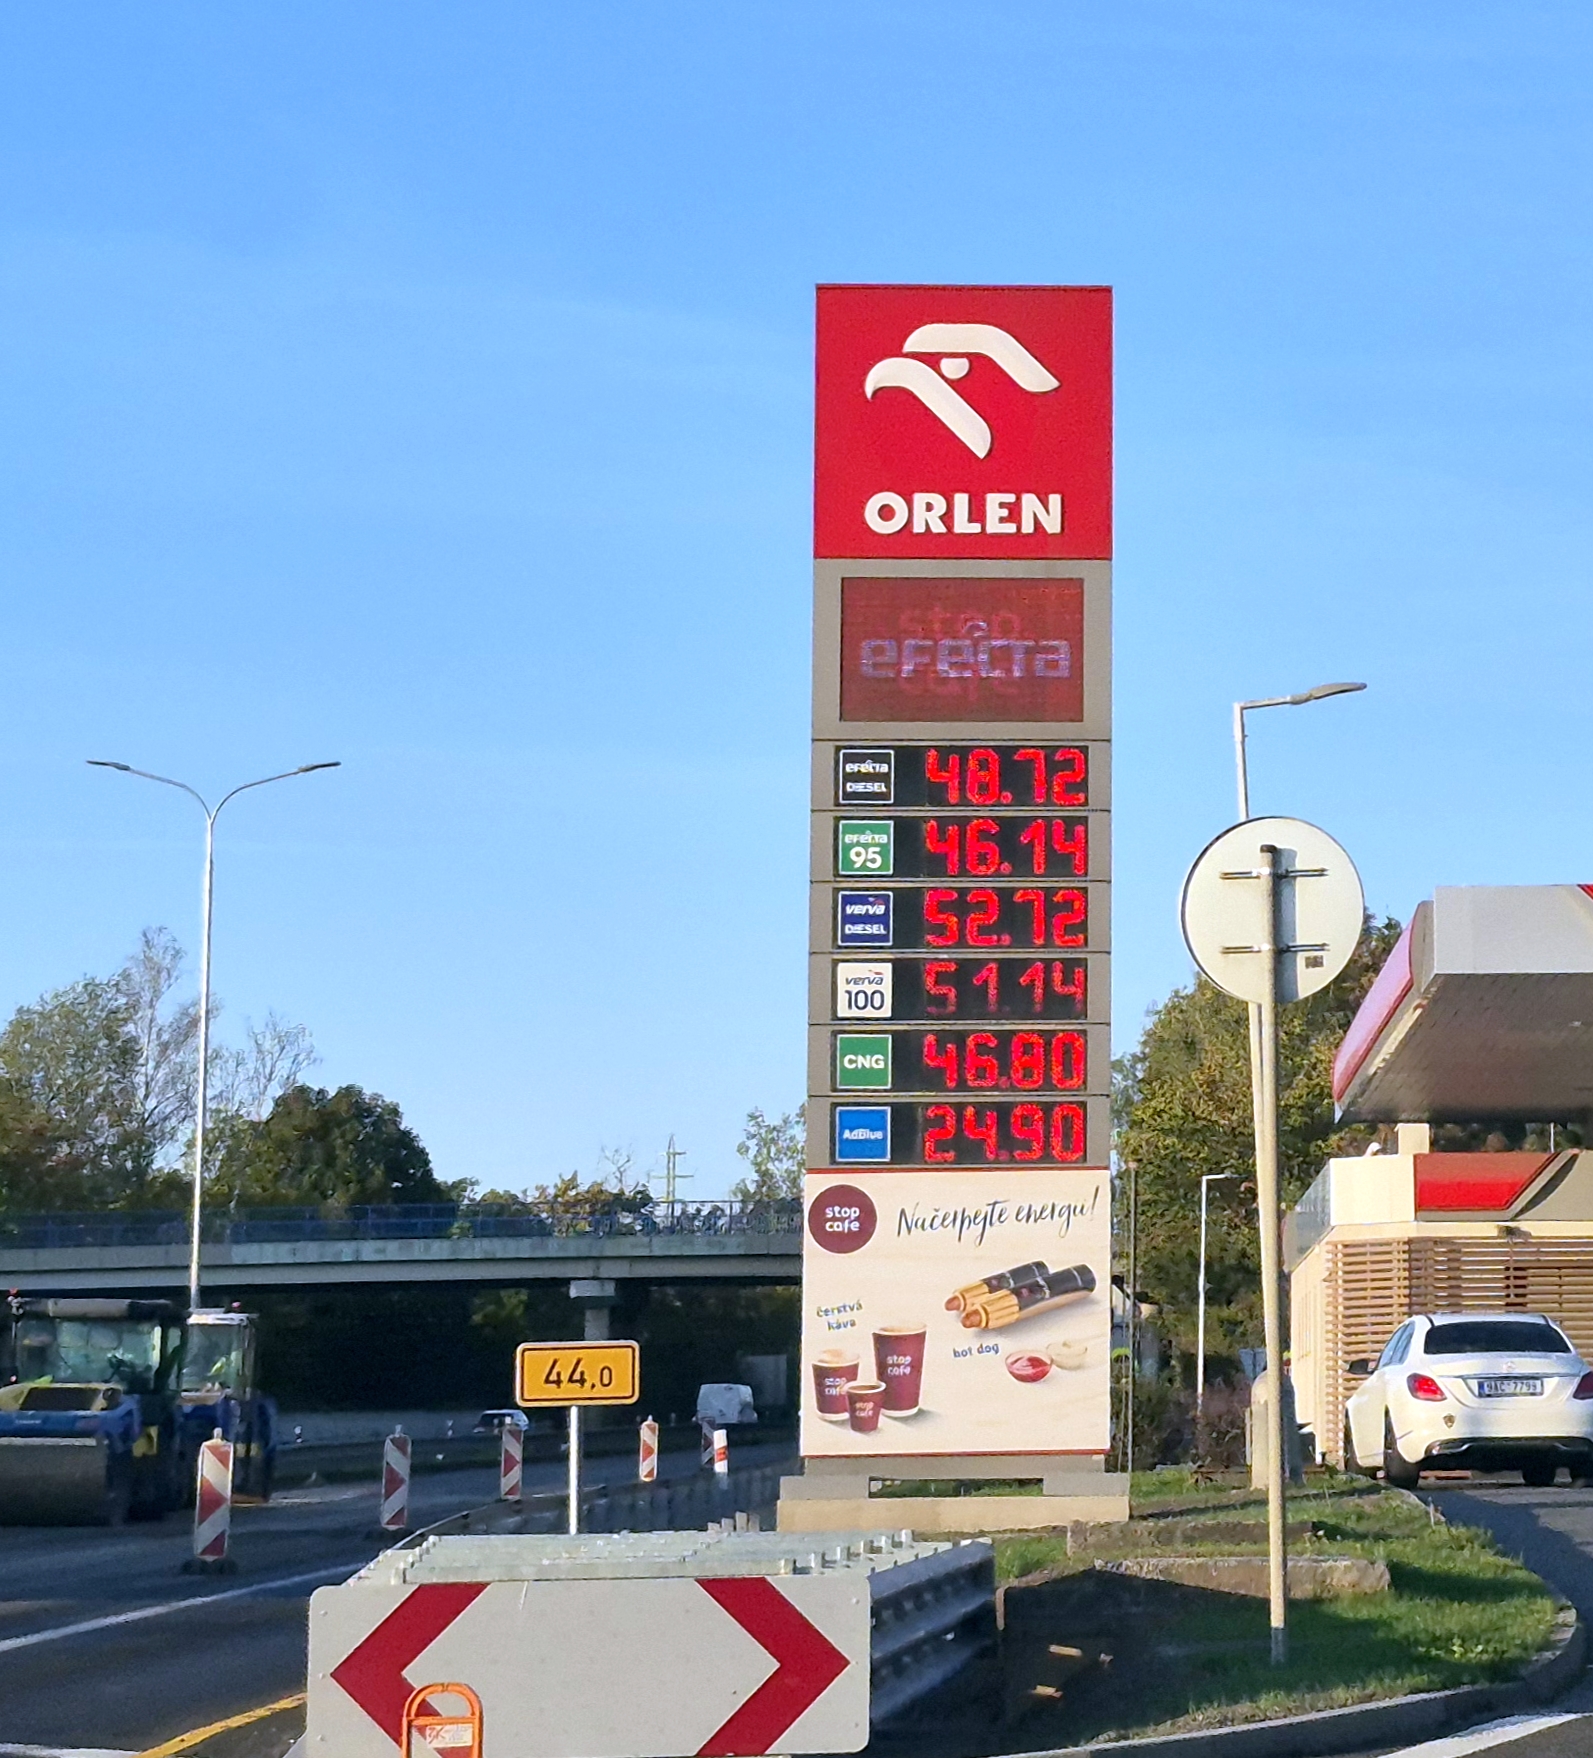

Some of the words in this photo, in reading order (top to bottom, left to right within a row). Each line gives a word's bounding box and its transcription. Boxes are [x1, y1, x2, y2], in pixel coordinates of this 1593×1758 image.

[864, 491, 1062, 535] ORLEN
[925, 748, 1086, 805] 48.72
[846, 782, 887, 792] DIESEL
[925, 818, 1086, 876] 46.14
[849, 846, 883, 869] 95
[845, 904, 886, 915] verva
[924, 888, 1086, 946] 52.72
[844, 924, 887, 935] DIESEL
[845, 974, 883, 986] verva
[844, 989, 885, 1011] 100
[843, 1054, 885, 1069] CNG
[923, 1032, 1086, 1090] 46.80
[843, 1128, 883, 1140] AdBlue
[923, 1103, 1085, 1162] 24.90
[825, 1205, 860, 1220] stop
[825, 1218, 860, 1234] cafe
[897, 1199, 1010, 1247] Načerpejte
[816, 1299, 863, 1318] čerstvá
[827, 1318, 857, 1332] káva
[952, 1346, 973, 1358] hot
[976, 1342, 1000, 1355] dog
[543, 1357, 613, 1391] 44,0
